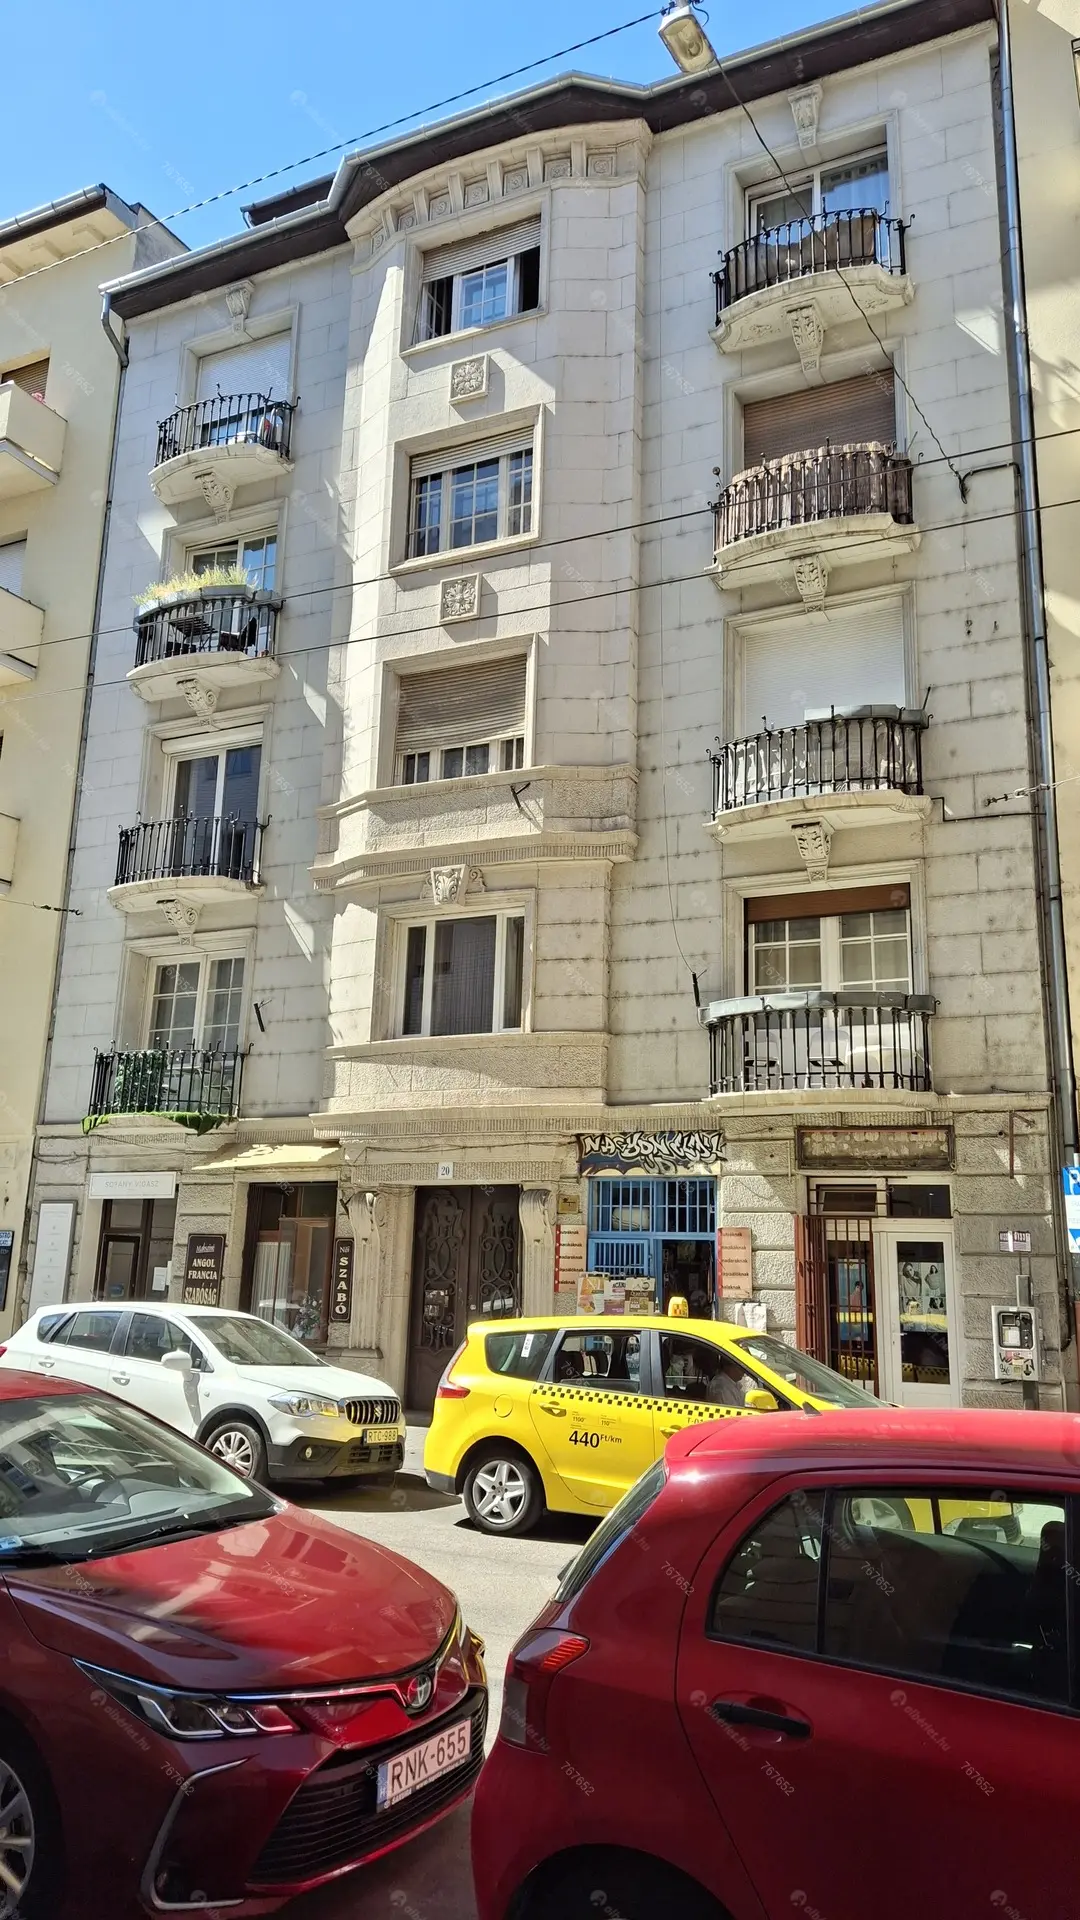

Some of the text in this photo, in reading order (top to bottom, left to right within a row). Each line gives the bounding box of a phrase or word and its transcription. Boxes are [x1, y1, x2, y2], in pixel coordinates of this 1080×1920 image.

[440, 1165, 450, 1176] 20
[192, 1258, 215, 1268] ANGOL
[188, 1270, 217, 1280] FRANCIA
[184, 1282, 217, 1305] SZABÓSÁG
[335, 1257, 349, 1314] SZABÓ
[569, 1430, 622, 1448] 440 Ft/km
[391, 1724, 466, 1794] RNK-655
